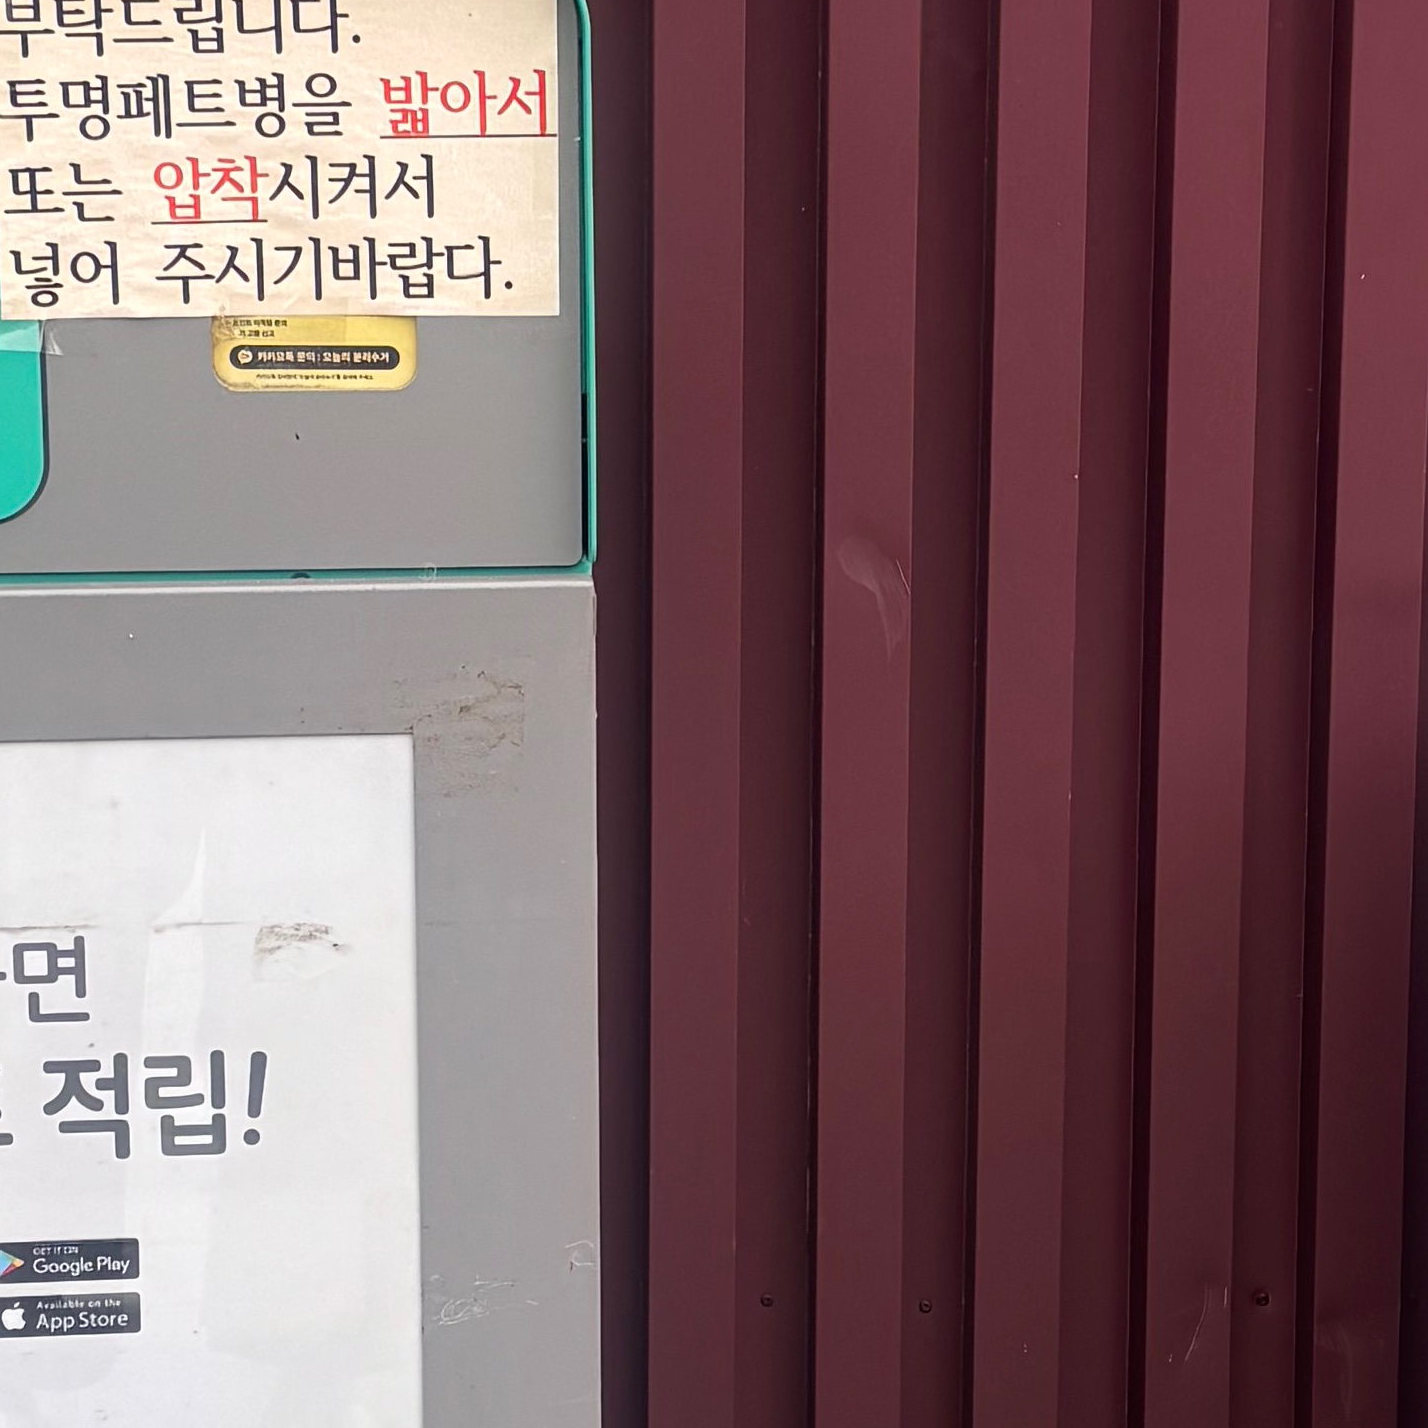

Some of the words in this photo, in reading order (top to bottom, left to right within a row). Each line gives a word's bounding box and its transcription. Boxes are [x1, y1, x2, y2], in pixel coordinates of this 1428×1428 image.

[0, 72, 351, 141] 투명페트병을
[380, 70, 549, 136] 밟아서
[5, 162, 122, 221] 또는
[154, 154, 434, 221] 압착시켜서
[10, 240, 119, 308] 넣어
[156, 237, 513, 304] 주시기바랍다.
[43, 1050, 268, 1159] 적립!
[33, 1257, 93, 1276] Google
[97, 1256, 130, 1274] Play
[36, 1313, 75, 1333] App
[79, 1312, 128, 1328] Store
[37, 1301, 84, 1309] Available
[104, 1299, 121, 1307] the
